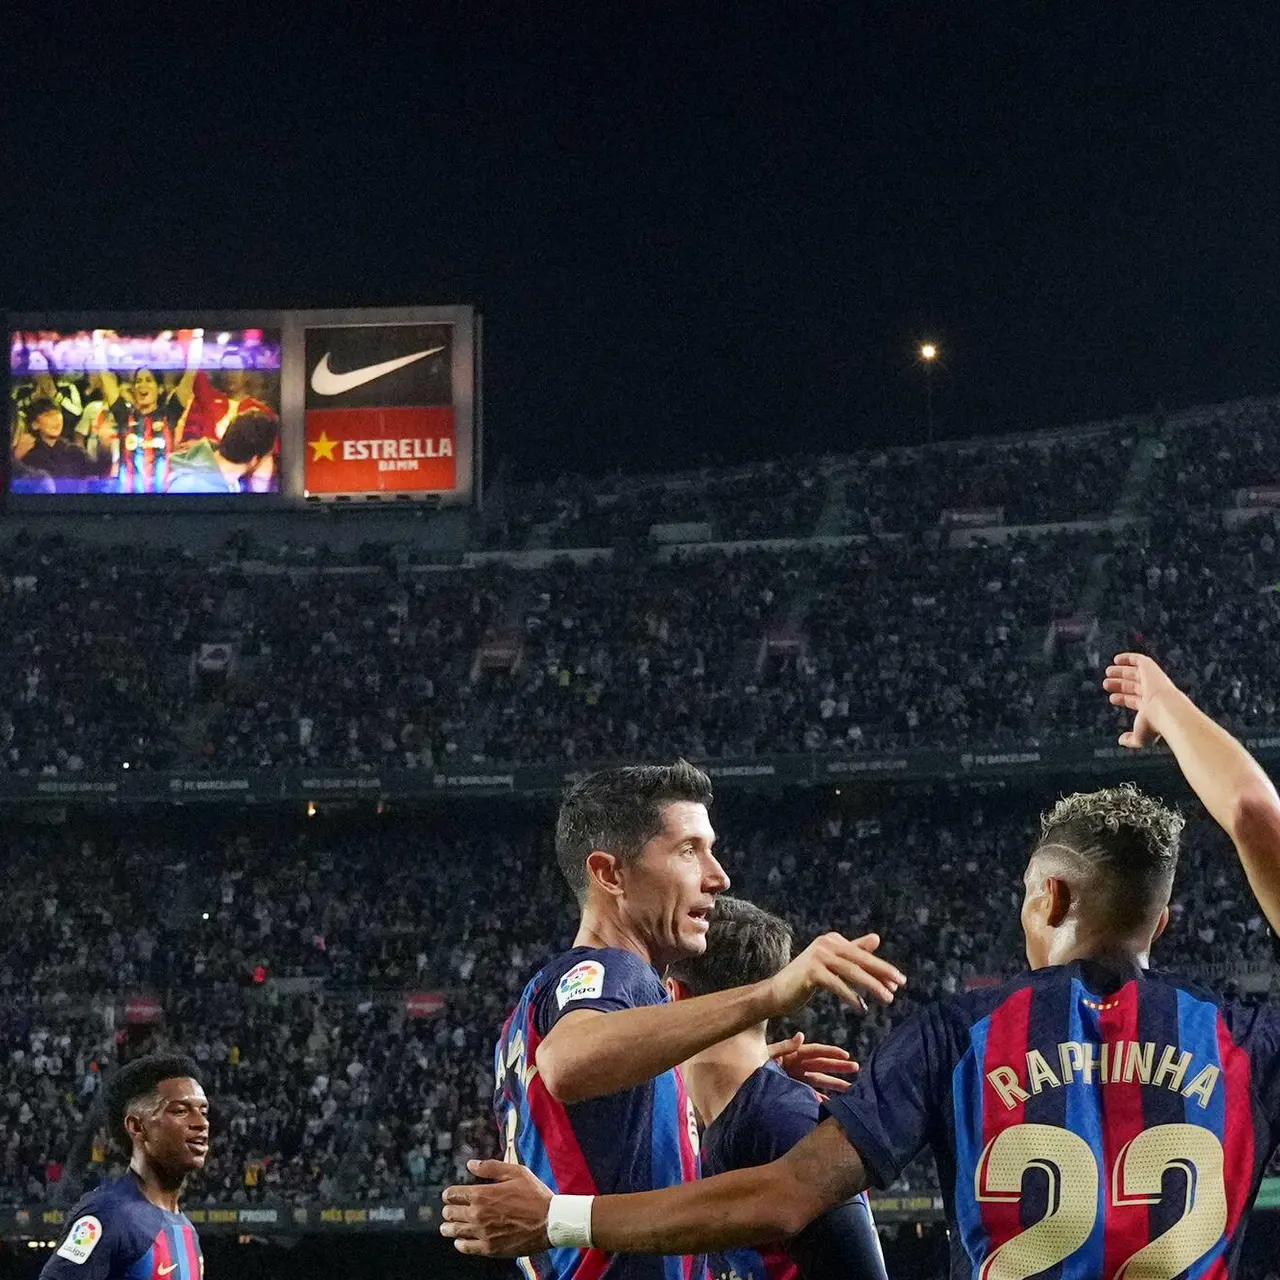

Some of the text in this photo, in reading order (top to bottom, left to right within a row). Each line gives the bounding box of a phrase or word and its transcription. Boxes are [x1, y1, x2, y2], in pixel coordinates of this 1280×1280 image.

[343, 438, 453, 460] ESTRELLA
[378, 460, 419, 471] DAMM
[566, 987, 596, 1000] aLiga
[986, 1040, 1223, 1110] RAPHINHA
[239, 1209, 277, 1223] PROUD
